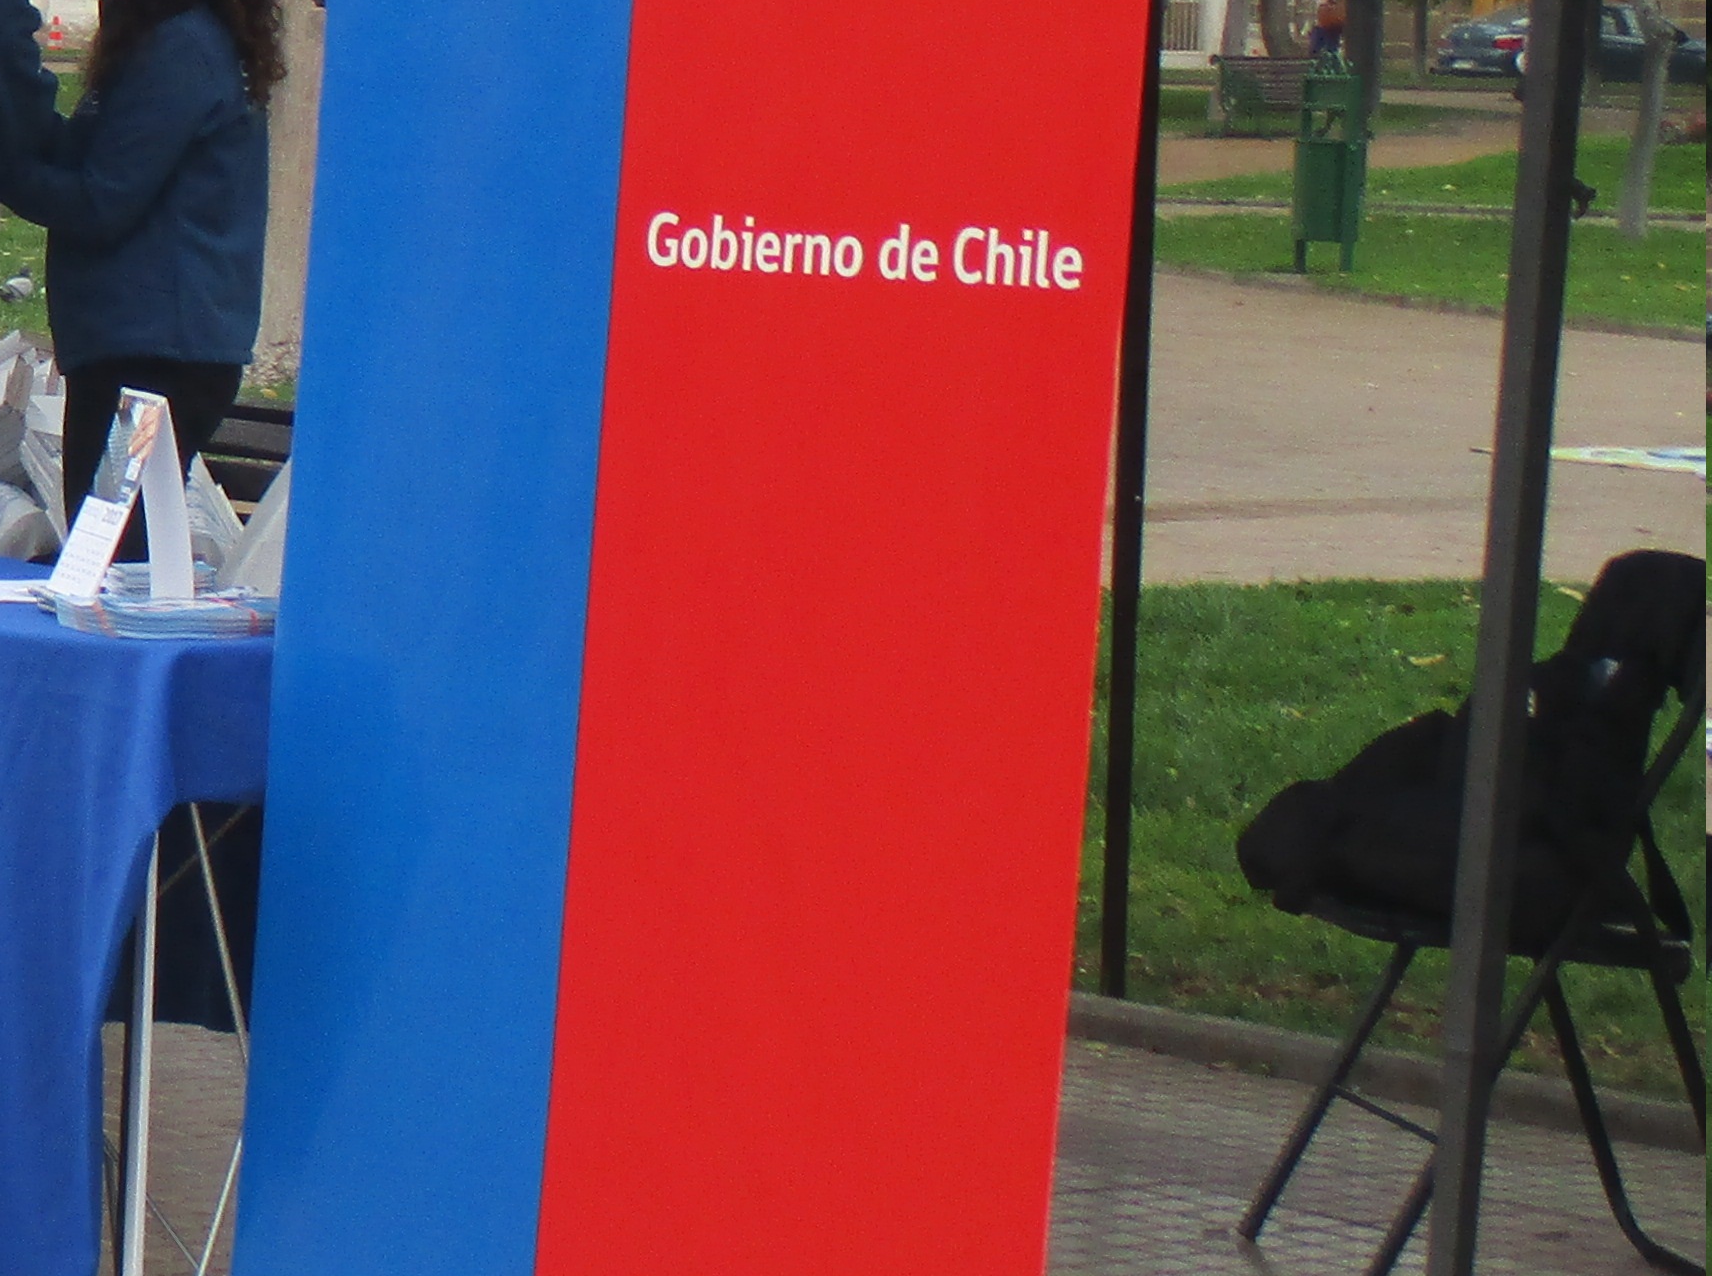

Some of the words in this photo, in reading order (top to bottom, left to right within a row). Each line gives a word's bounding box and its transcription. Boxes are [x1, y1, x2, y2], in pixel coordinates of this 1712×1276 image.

[646, 211, 864, 278] Gobierno
[878, 223, 940, 282] de
[952, 226, 1084, 290] Chile
